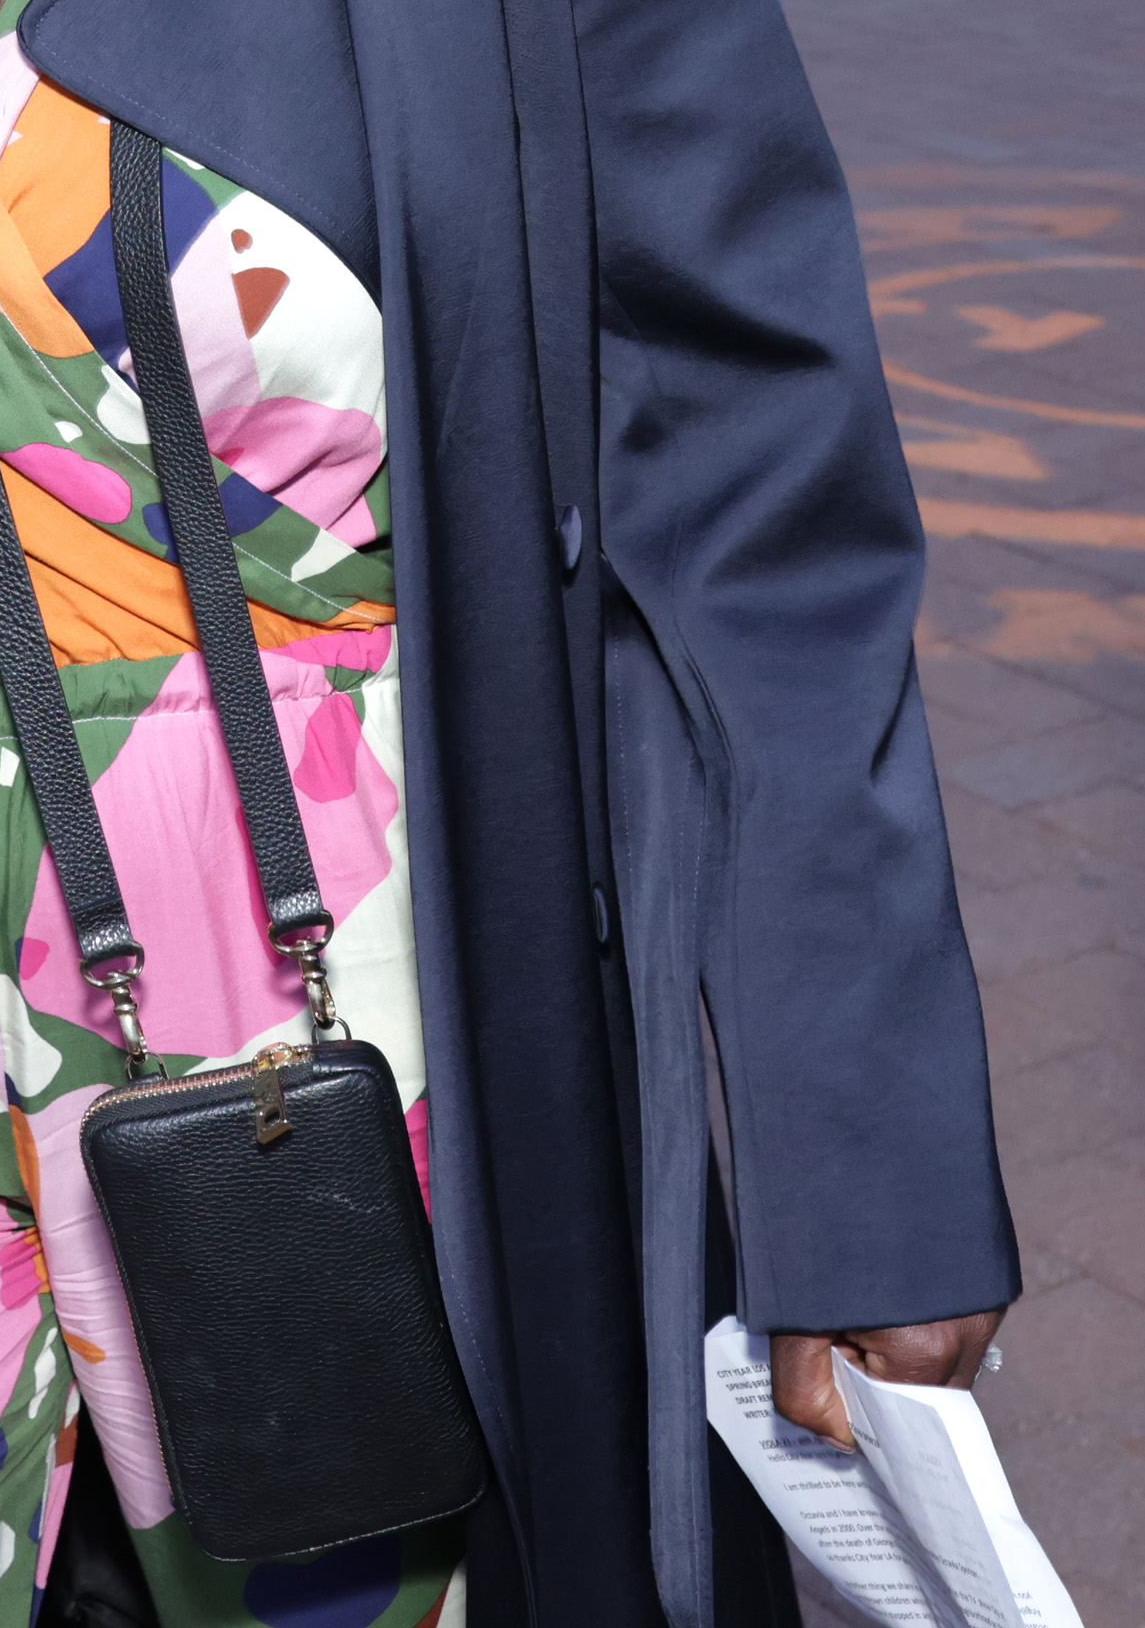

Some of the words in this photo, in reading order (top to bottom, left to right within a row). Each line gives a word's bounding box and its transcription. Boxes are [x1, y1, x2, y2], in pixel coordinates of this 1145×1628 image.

[717, 1370, 732, 1378] CITY
[732, 1366, 752, 1376] YEAR
[752, 1364, 766, 1373] LOS
[726, 1381, 752, 1391] SPRING
[752, 1379, 771, 1388] BREA
[735, 1395, 757, 1404] DRAFT
[798, 1480, 823, 1490] thrilled
